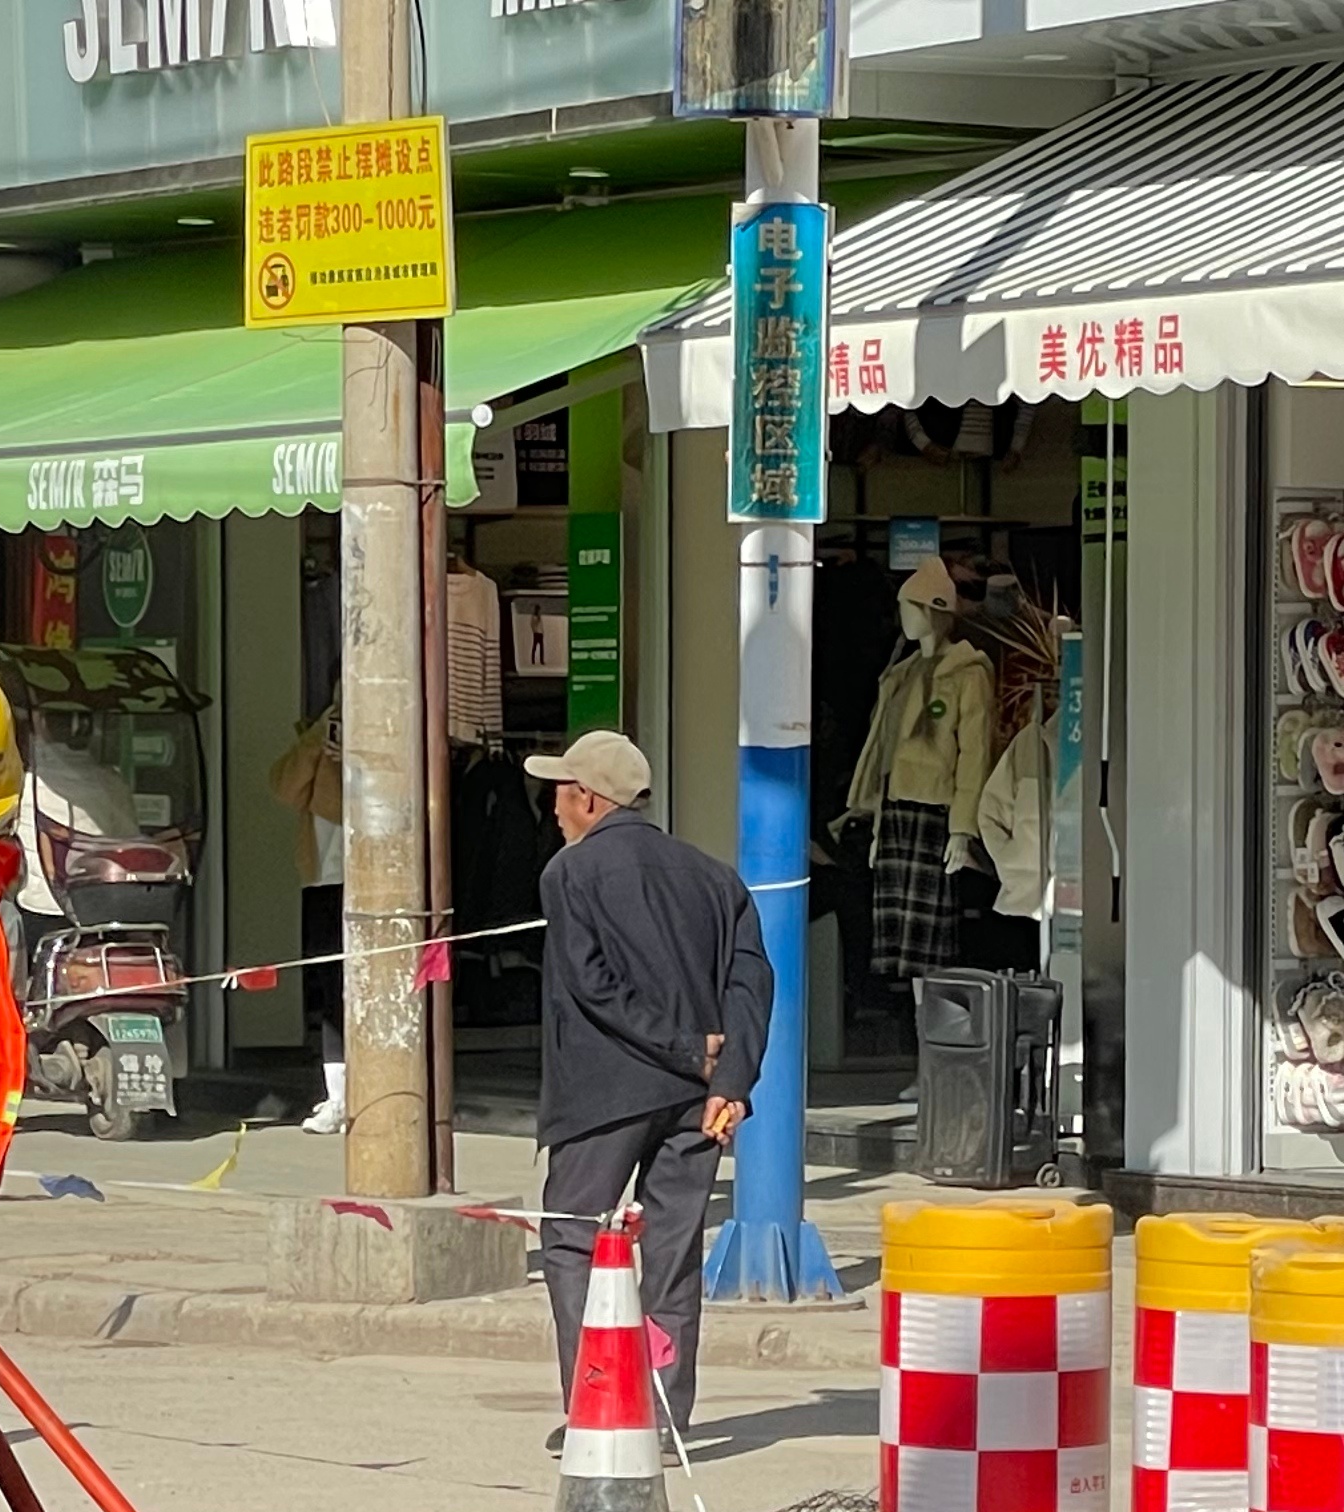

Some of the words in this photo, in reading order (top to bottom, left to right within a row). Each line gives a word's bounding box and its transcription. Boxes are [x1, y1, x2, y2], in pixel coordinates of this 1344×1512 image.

[258, 136, 434, 188] 此路段禁止摆摊设点
[258, 194, 436, 245] 违者罚款300-1000元
[751, 216, 804, 508] 电子监控区域
[1039, 314, 1184, 383] 美优精品
[91, 454, 145, 509] 森马
